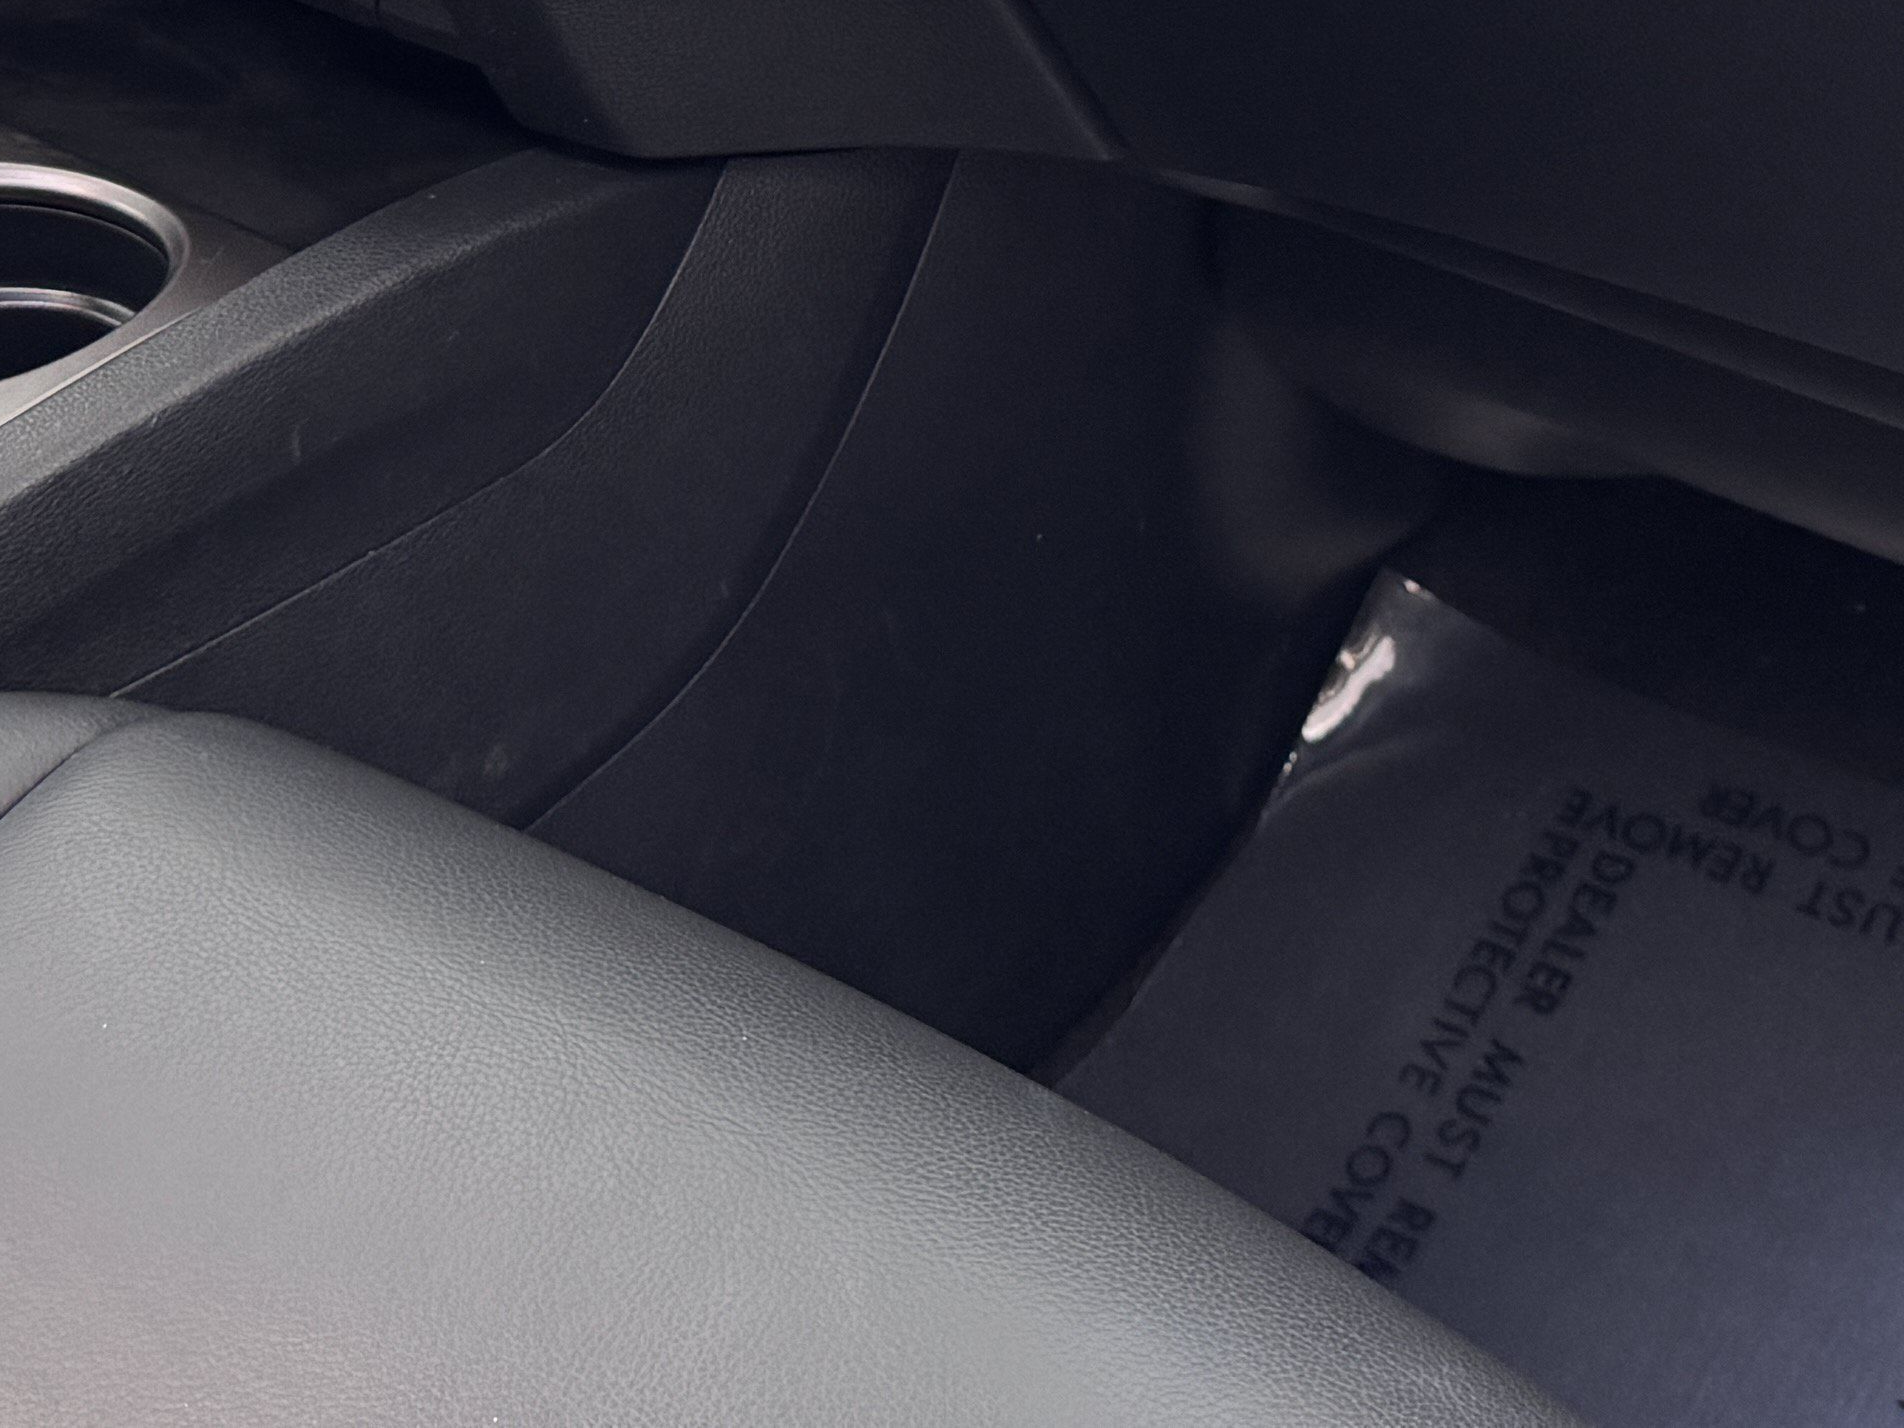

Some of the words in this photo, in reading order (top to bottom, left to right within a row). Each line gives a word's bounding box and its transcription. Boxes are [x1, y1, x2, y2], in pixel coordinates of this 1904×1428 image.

[1555, 787, 1778, 897] REMOVE
[1699, 781, 1872, 871] COVER
[1397, 829, 1582, 1096] PROTECTIVE
[1514, 848, 1637, 1016] DEALER
[1423, 1038, 1526, 1182] MUST
